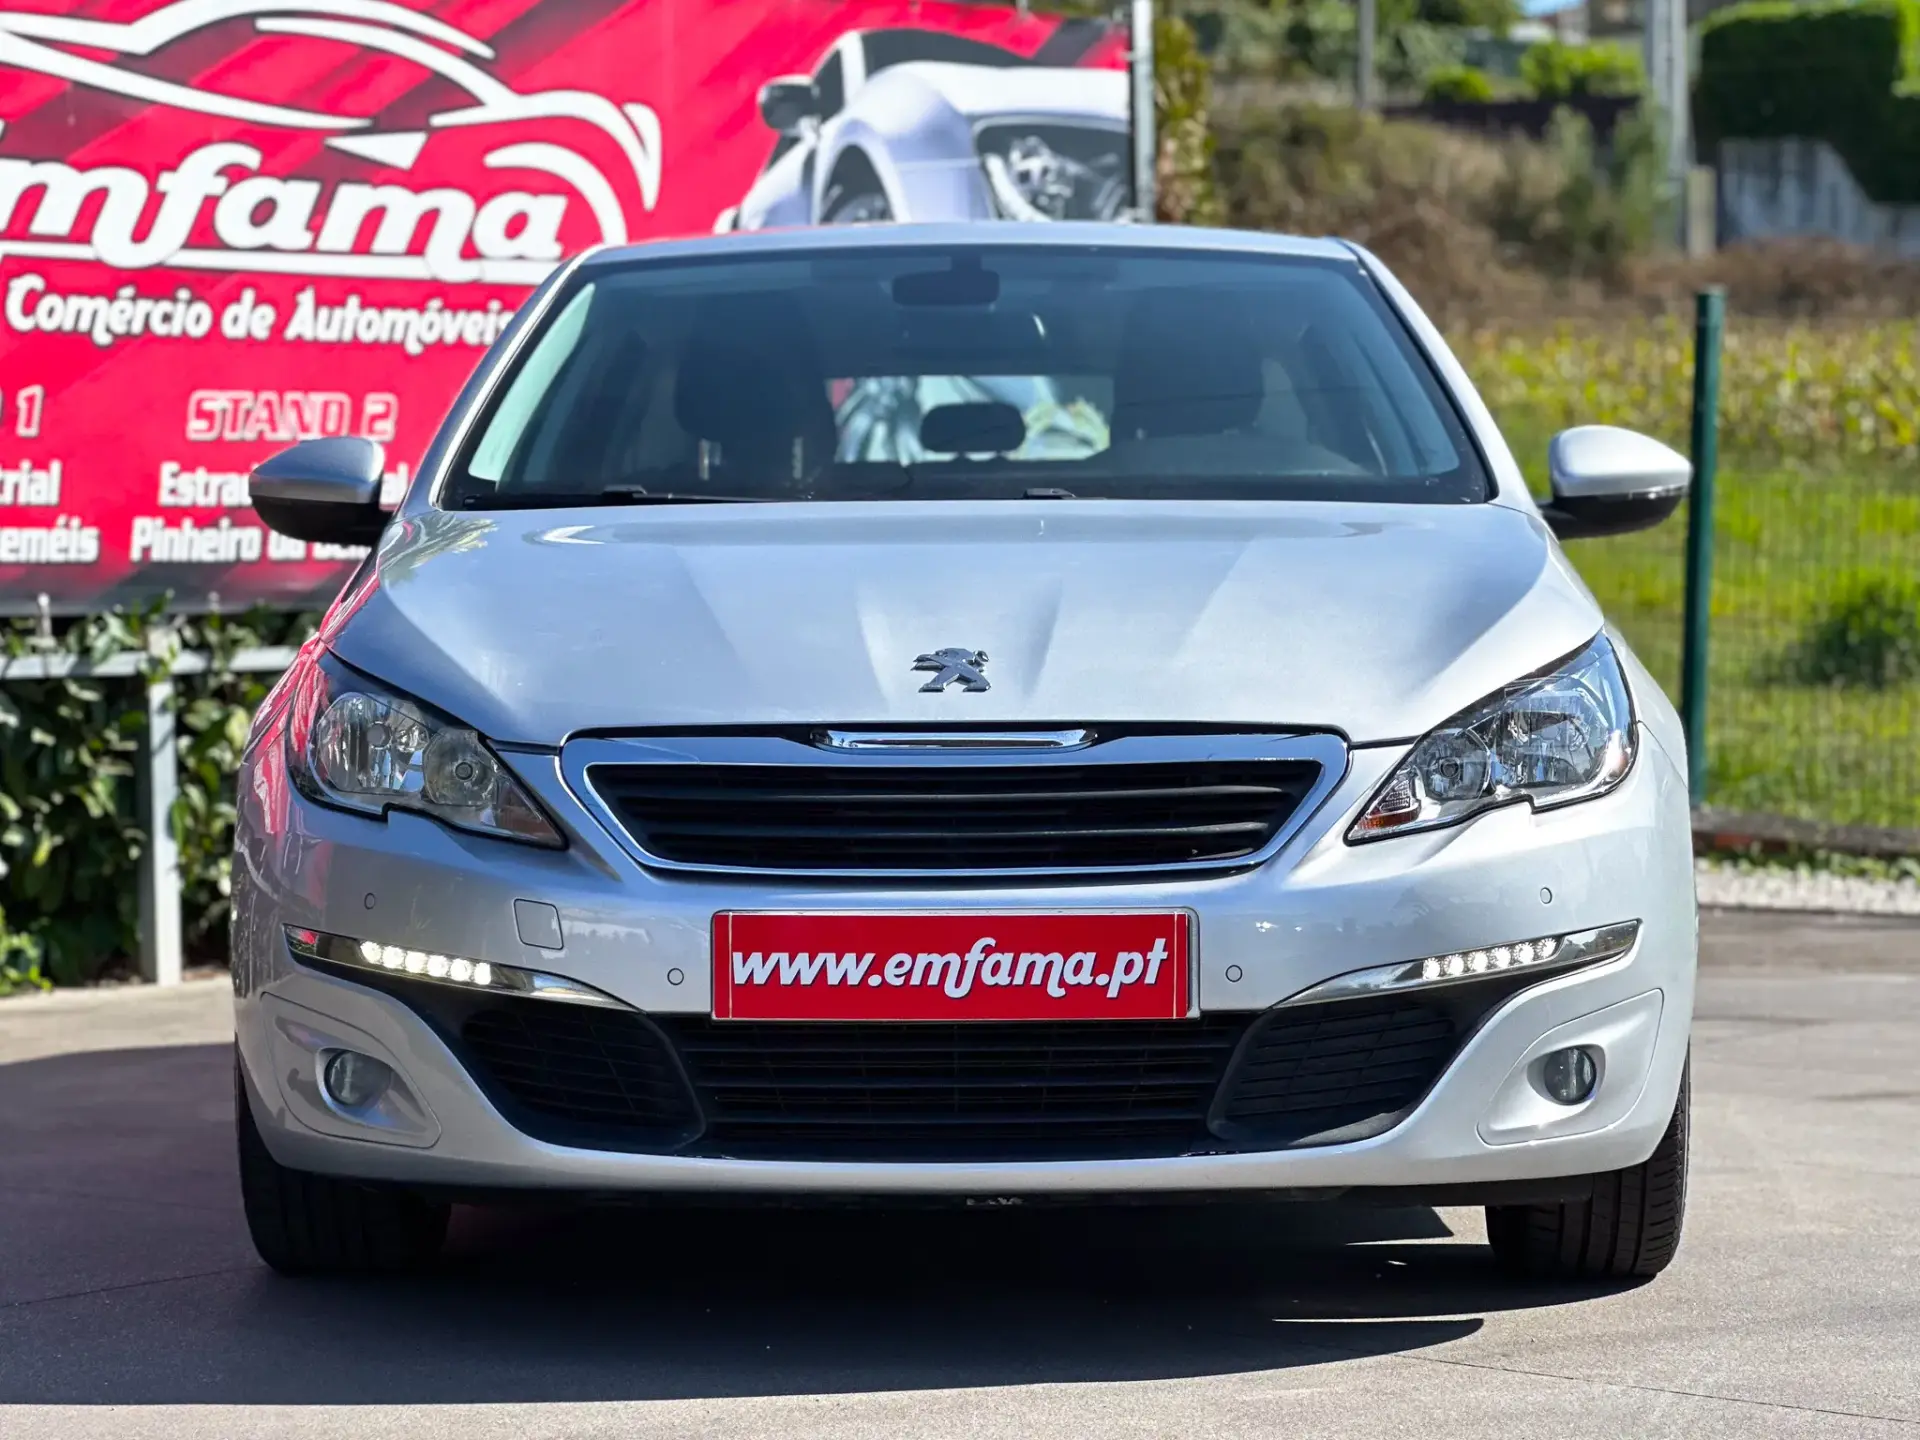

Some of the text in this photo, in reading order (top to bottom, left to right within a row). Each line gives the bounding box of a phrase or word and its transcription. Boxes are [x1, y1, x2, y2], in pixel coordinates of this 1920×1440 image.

[5, 272, 213, 347] Comércio
[221, 286, 276, 341] de
[186, 389, 399, 442] STAND 2
[130, 516, 262, 562] Pinheiro
[731, 936, 1169, 999] www.emfama.pt
